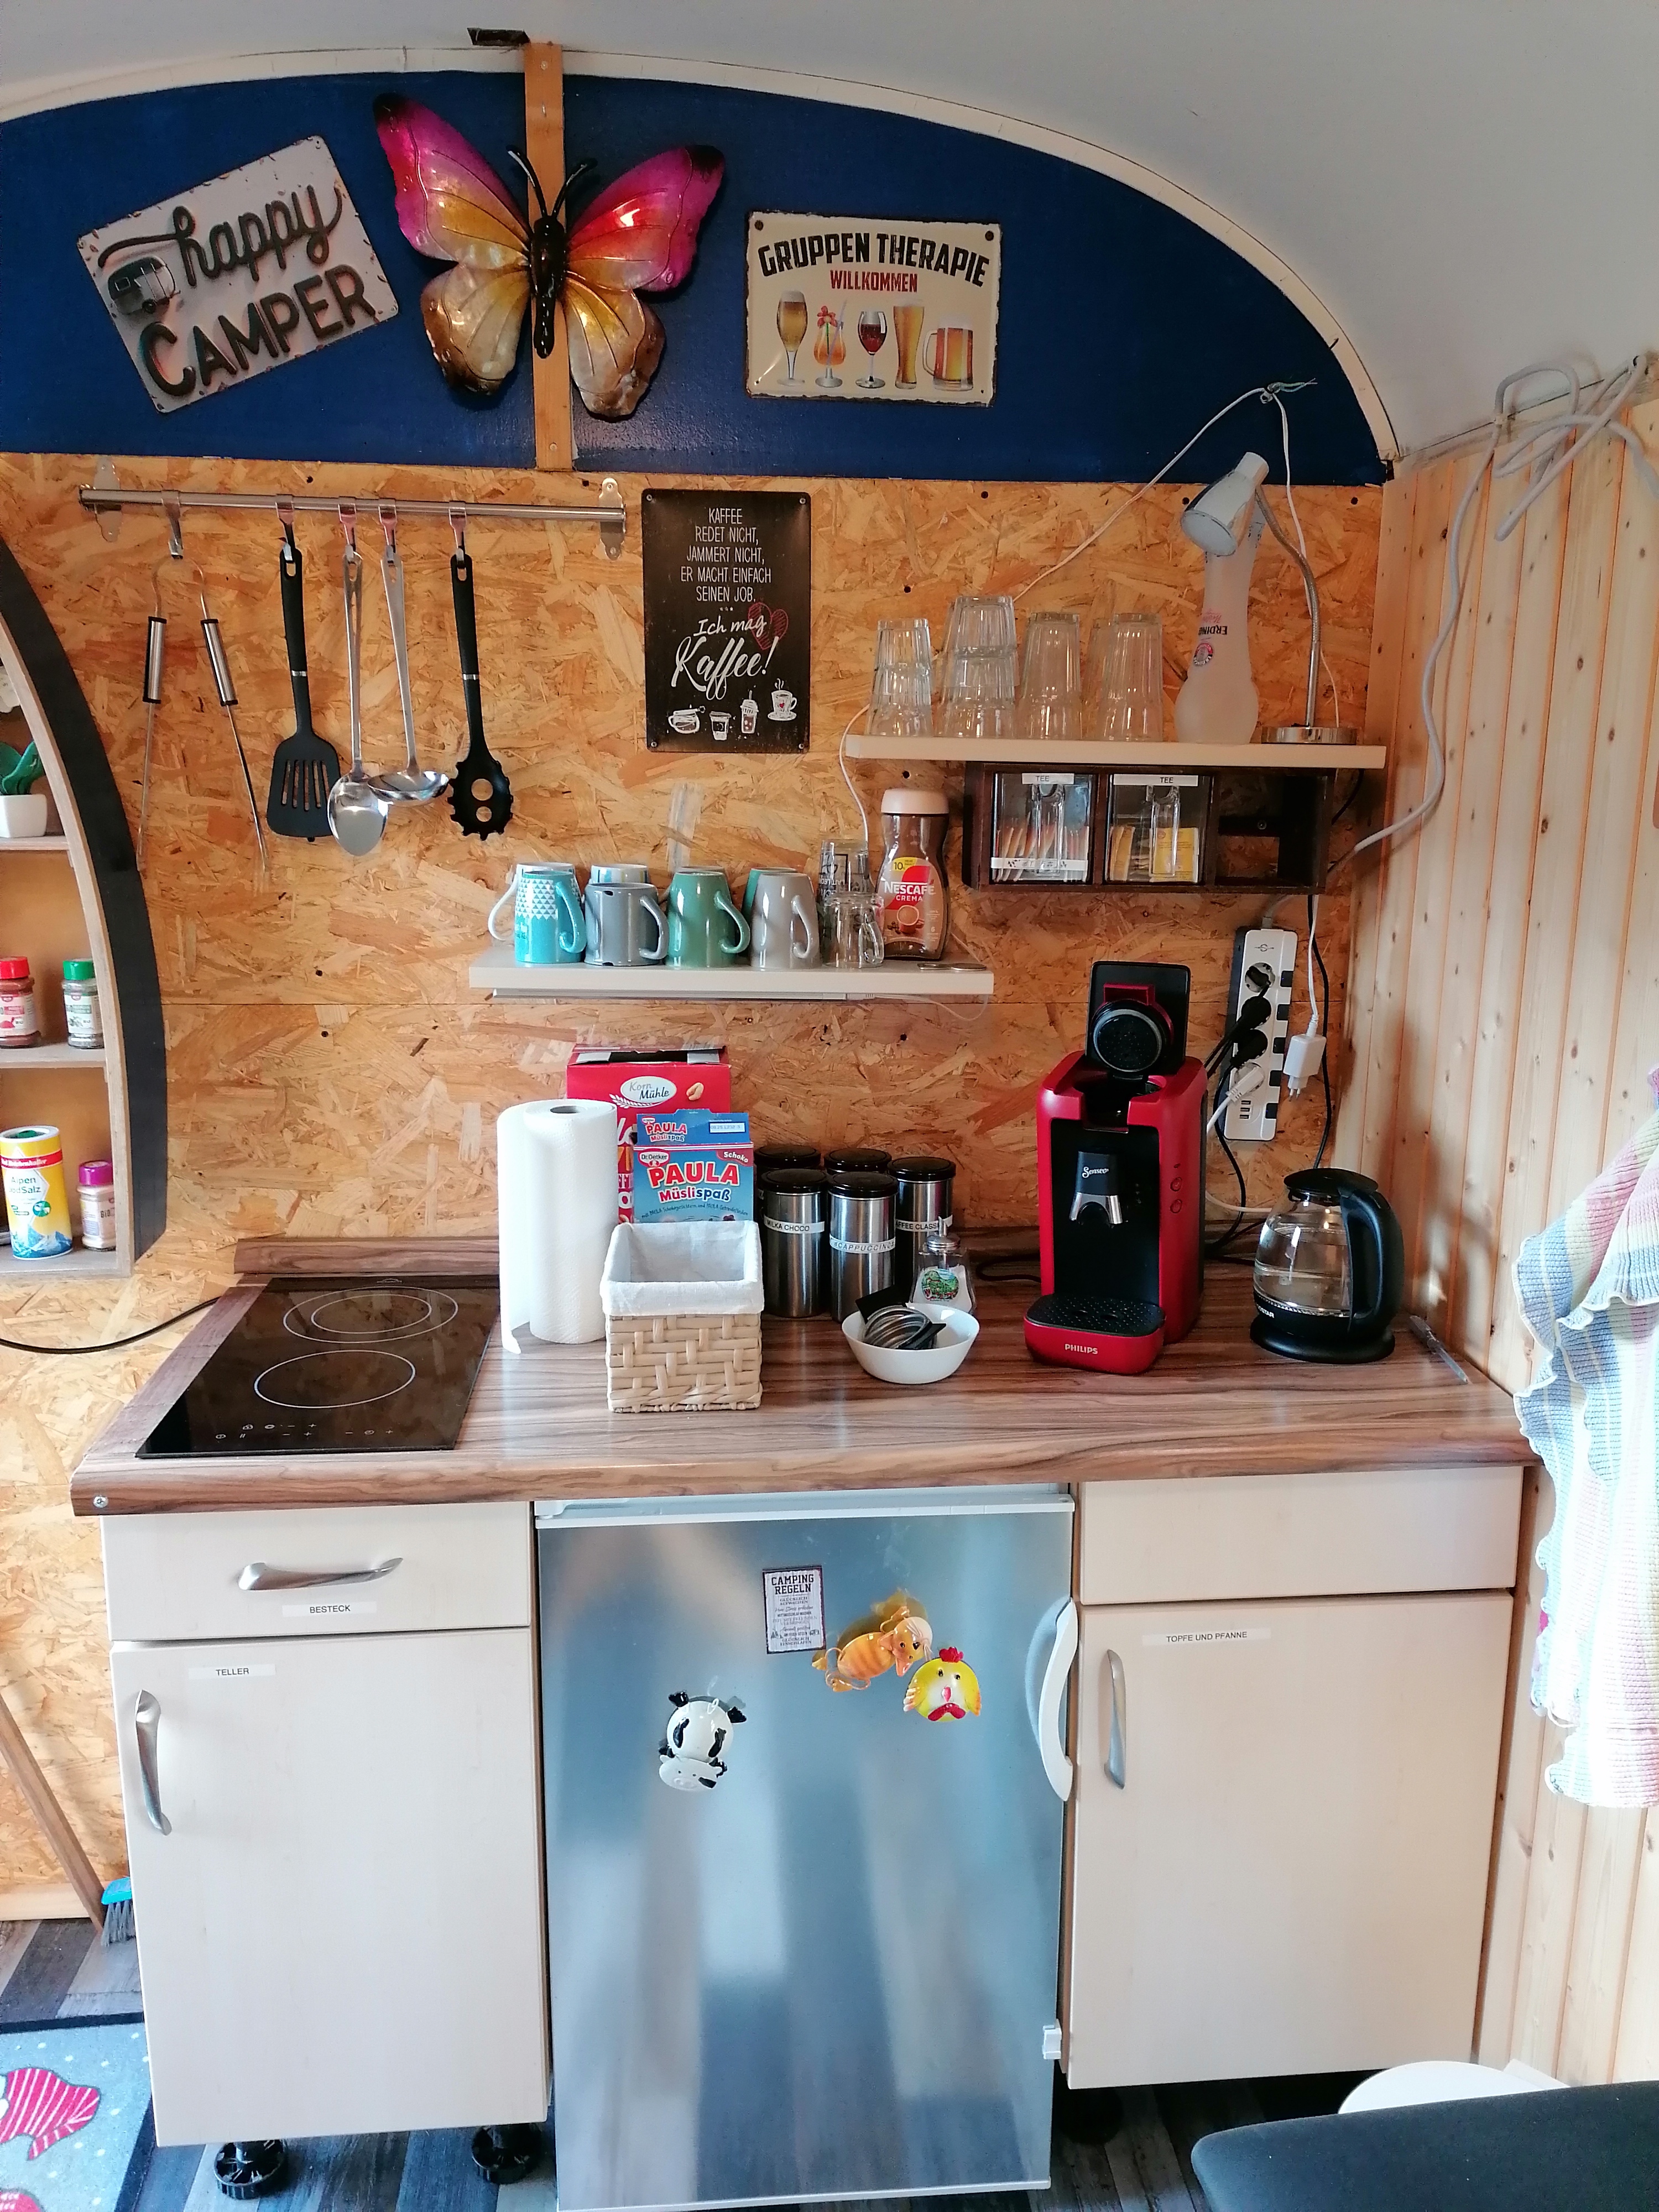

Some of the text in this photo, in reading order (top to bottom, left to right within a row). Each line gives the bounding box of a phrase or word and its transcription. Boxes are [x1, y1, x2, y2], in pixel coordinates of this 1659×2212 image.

[98, 184, 342, 286] happy
[758, 233, 990, 287] GRUPPEN THERAPIE
[830, 269, 917, 293] WILLKOMMEN
[139, 264, 377, 397] CAMPER
[708, 508, 743, 524] KAFFEE
[695, 526, 759, 545] REDET NICHT,
[686, 546, 765, 565] JAMMERT NICHT,
[681, 567, 771, 584] ER MACHT EINFACH
[696, 586, 756, 603] SEINEN JOB.
[693, 614, 768, 638] Ich mag
[671, 635, 779, 701] Kaffee!
[629, 1081, 653, 1092] Korn
[639, 1088, 670, 1100] Mühle
[645, 1122, 687, 1135] PAULA
[650, 1134, 685, 1142] Müslispaß
[723, 1151, 749, 1164] Schoko
[11, 1176, 36, 1185] Alpen
[648, 1161, 740, 1188] PAULA
[659, 1187, 731, 1203] Müslispaß
[1065, 1343, 1098, 1354] PHILIPS
[771, 1574, 814, 1585] CAMPING
[775, 1584, 811, 1594] REGELN
[309, 1605, 351, 1614] BESTECK
[1166, 1634, 1193, 1642] TOPFE
[1215, 1631, 1247, 1640] PFANNE
[216, 1668, 249, 1676] TELLER
